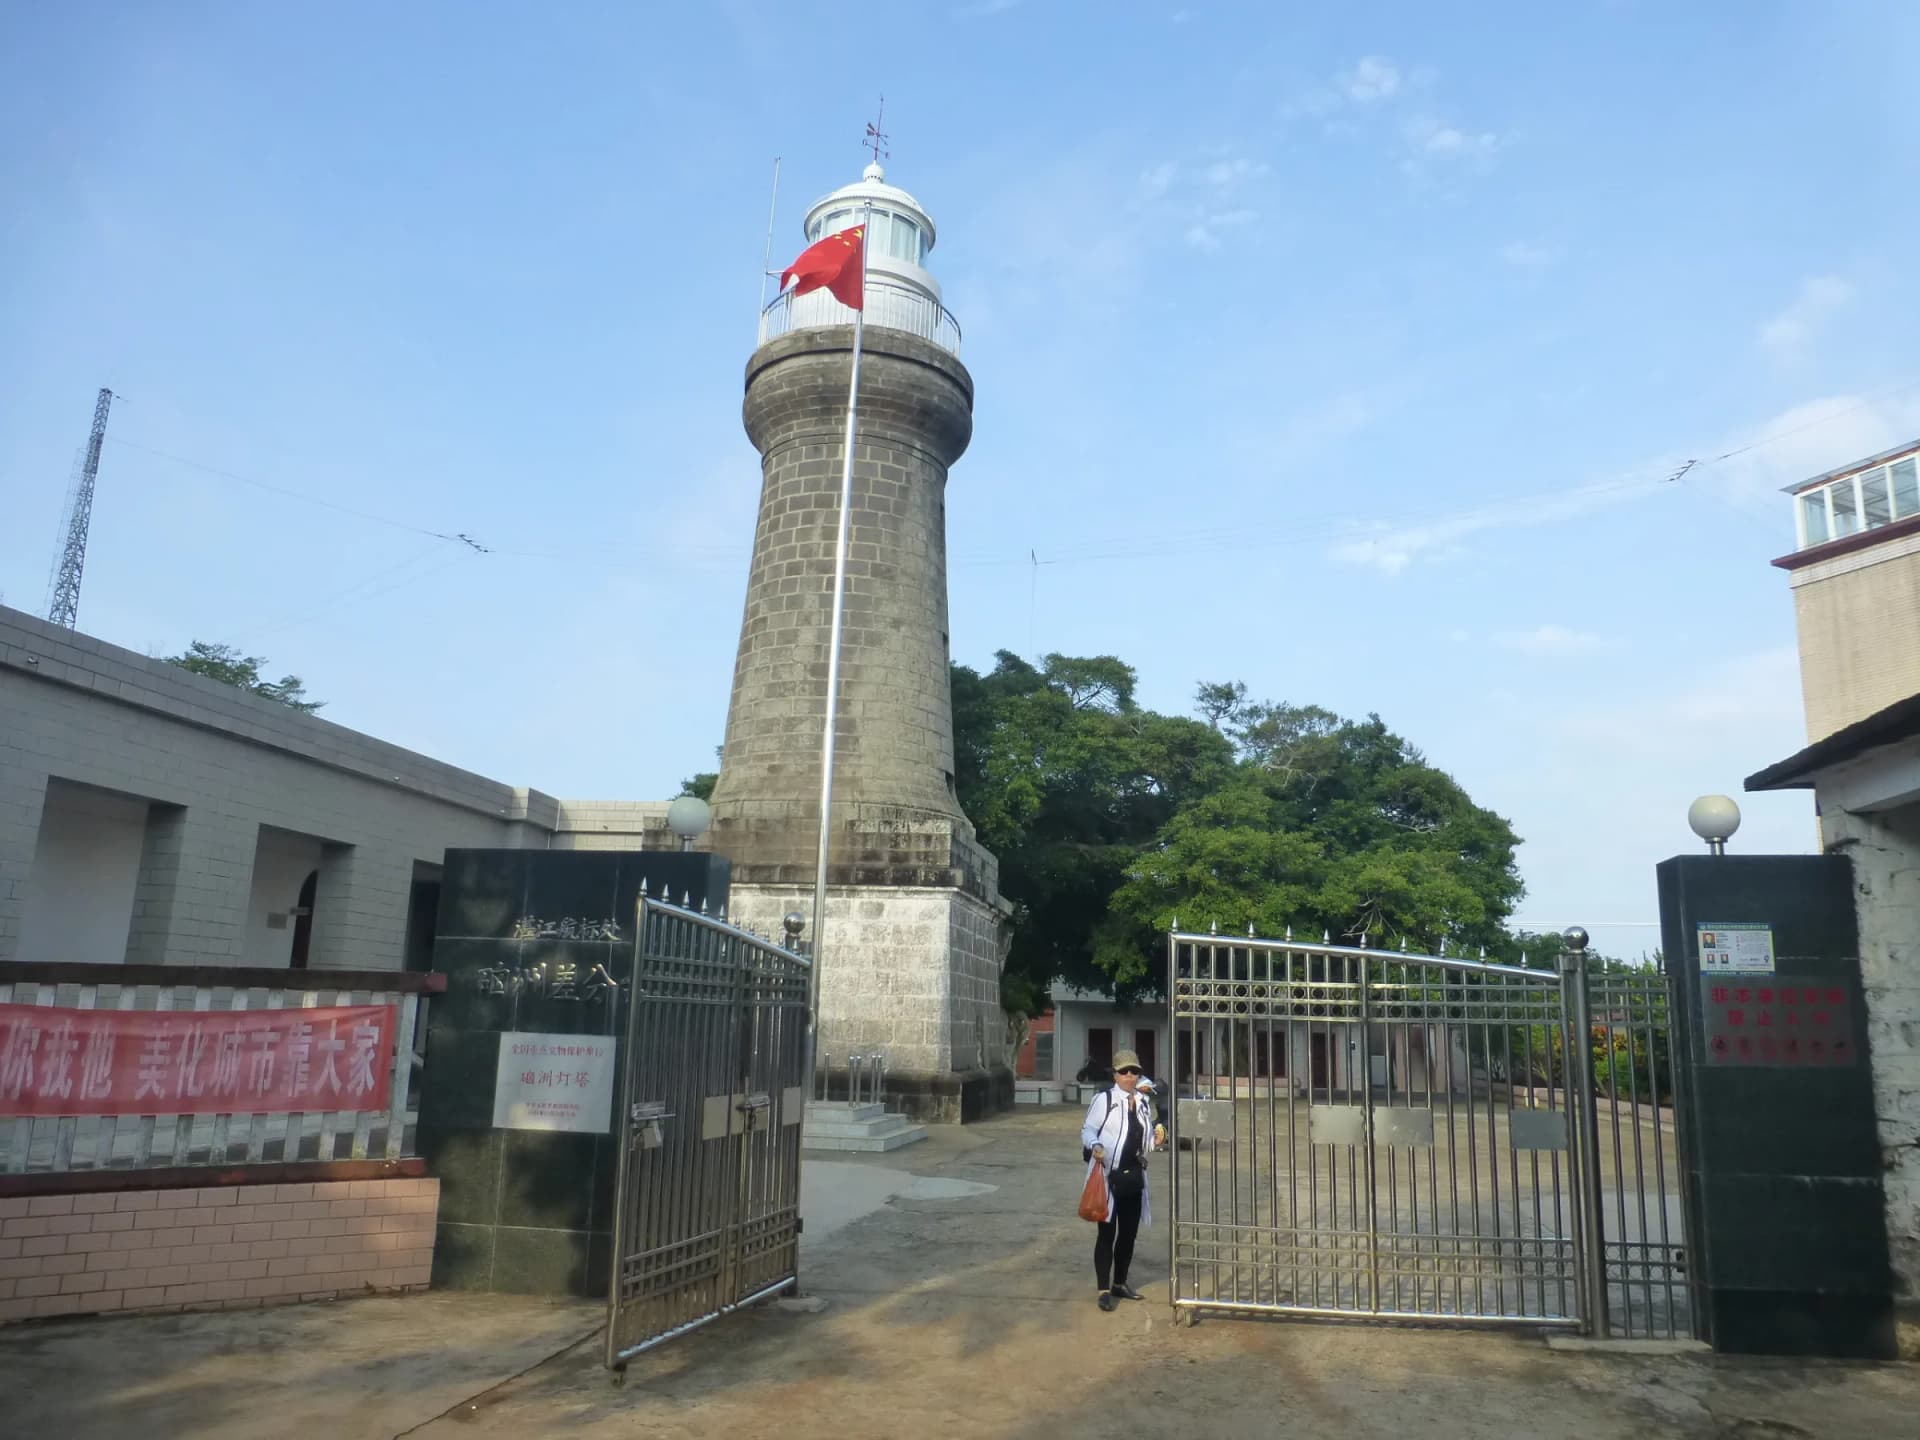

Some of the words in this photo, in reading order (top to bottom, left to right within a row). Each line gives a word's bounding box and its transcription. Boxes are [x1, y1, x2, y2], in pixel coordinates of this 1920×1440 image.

[513, 914, 622, 942] 湛江航标处
[1, 1019, 116, 1100] 你我他
[134, 1018, 380, 1100] 美化城市靠大家
